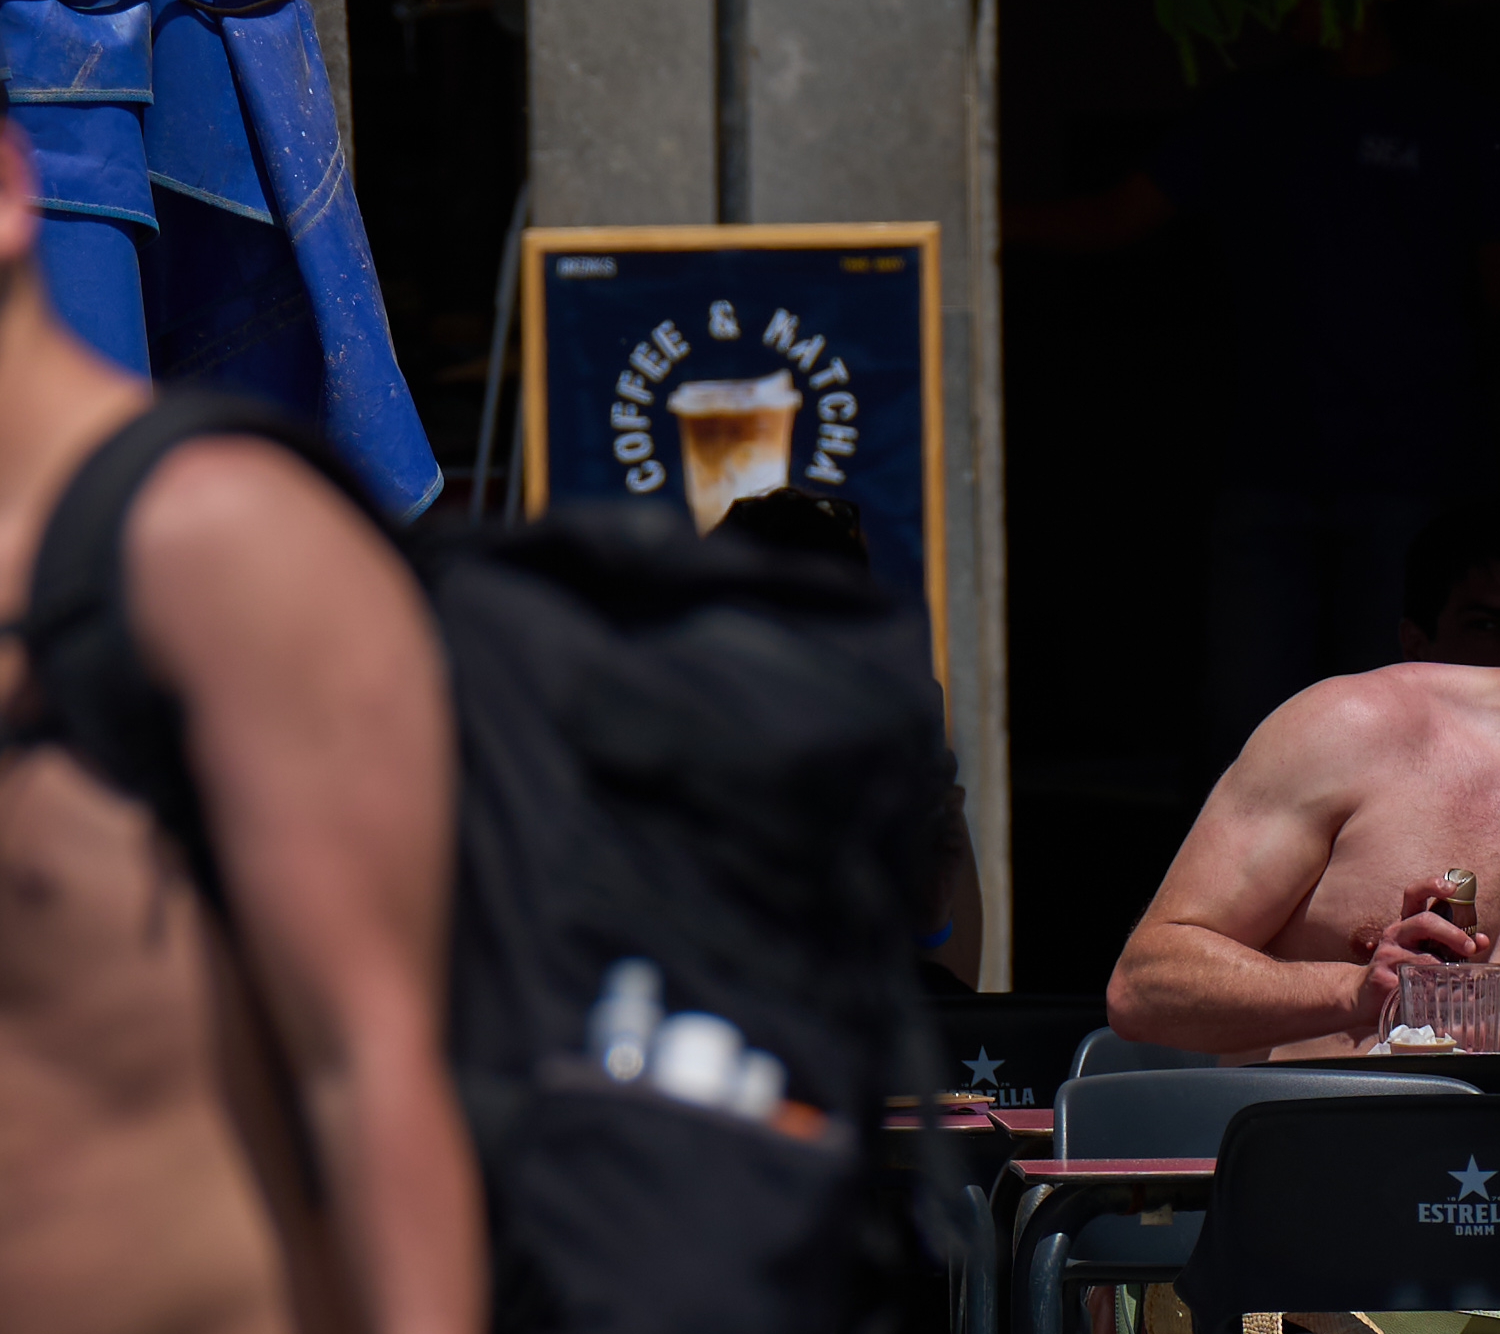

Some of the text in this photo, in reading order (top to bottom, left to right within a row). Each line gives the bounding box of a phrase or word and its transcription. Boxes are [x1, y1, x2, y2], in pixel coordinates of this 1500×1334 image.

[610, 299, 860, 494] COFFEE & MATCHA
[1455, 1225, 1495, 1236] DAMM
